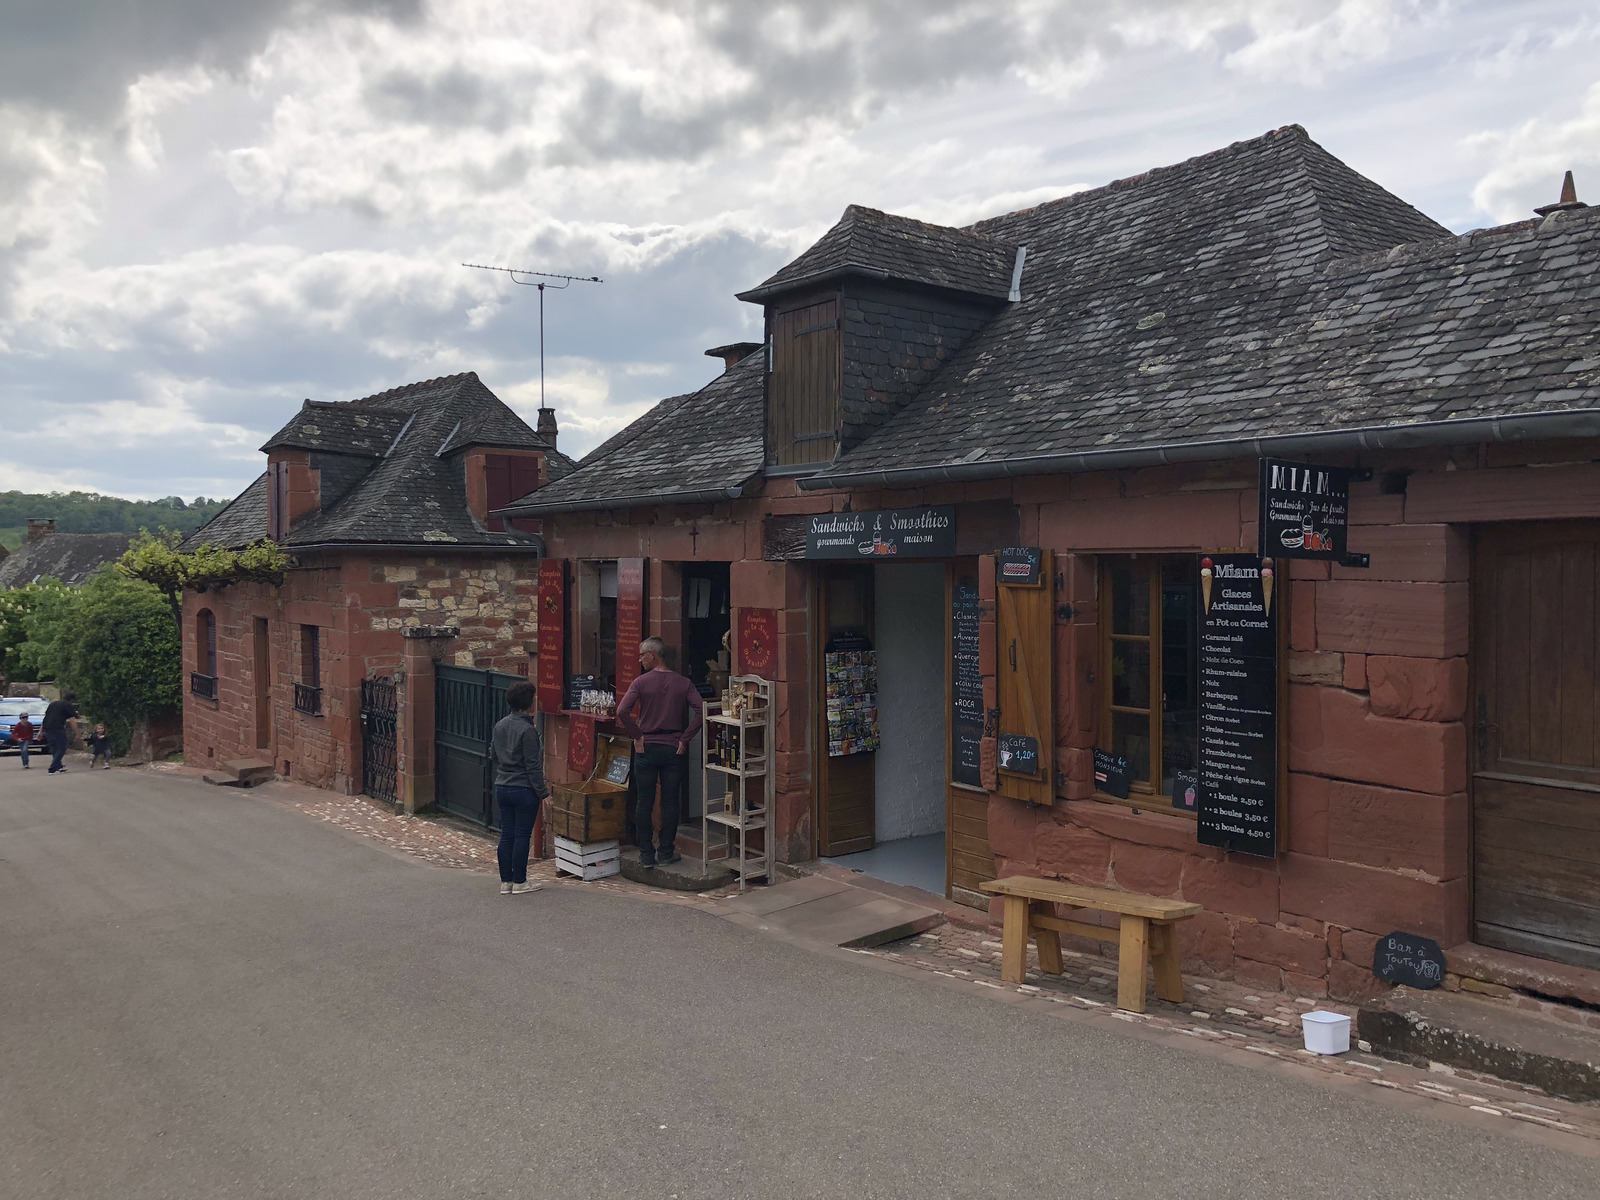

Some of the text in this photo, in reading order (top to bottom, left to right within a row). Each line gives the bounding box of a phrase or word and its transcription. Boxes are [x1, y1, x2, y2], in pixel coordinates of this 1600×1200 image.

[1270, 498, 1345, 515] Sandwichs Jus de fruits
[811, 510, 949, 533] Sandwichs & Smoothies
[1270, 509, 1345, 525] Gourmands Maison
[816, 533, 933, 549] gourmands maison
[1003, 547, 1029, 557] HOT DOG
[1214, 564, 1259, 578] Miam
[1222, 588, 1252, 598] Glaces
[1211, 601, 1264, 612] Artisanales
[956, 611, 977, 620] Classic
[1216, 618, 1230, 626] Pot
[1240, 619, 1269, 628] Cornet
[1206, 668, 1248, 678] Rhum-raisins
[1206, 691, 1238, 700] Barbapapa
[958, 699, 975, 708] ROCA
[1206, 702, 1226, 710] Vanille
[1205, 714, 1224, 722] Citron
[1206, 726, 1224, 734] Fraise
[1008, 738, 1026, 748] Café
[1205, 737, 1224, 745] Cassis
[1016, 750, 1035, 760] 1,20€
[1206, 748, 1236, 758] Framboise
[1206, 760, 1230, 769] Mangue
[1205, 771, 1224, 780] Pêche
[1232, 776, 1250, 784] vigne
[1205, 780, 1220, 788] Café
[1218, 792, 1238, 802] boule
[1240, 798, 1257, 806] 2,50
[1219, 807, 1242, 818] boules
[1244, 813, 1262, 822] 3,50
[1221, 822, 1244, 834] boules
[1247, 829, 1264, 838] 4,50
[1388, 938, 1426, 957] Bar à
